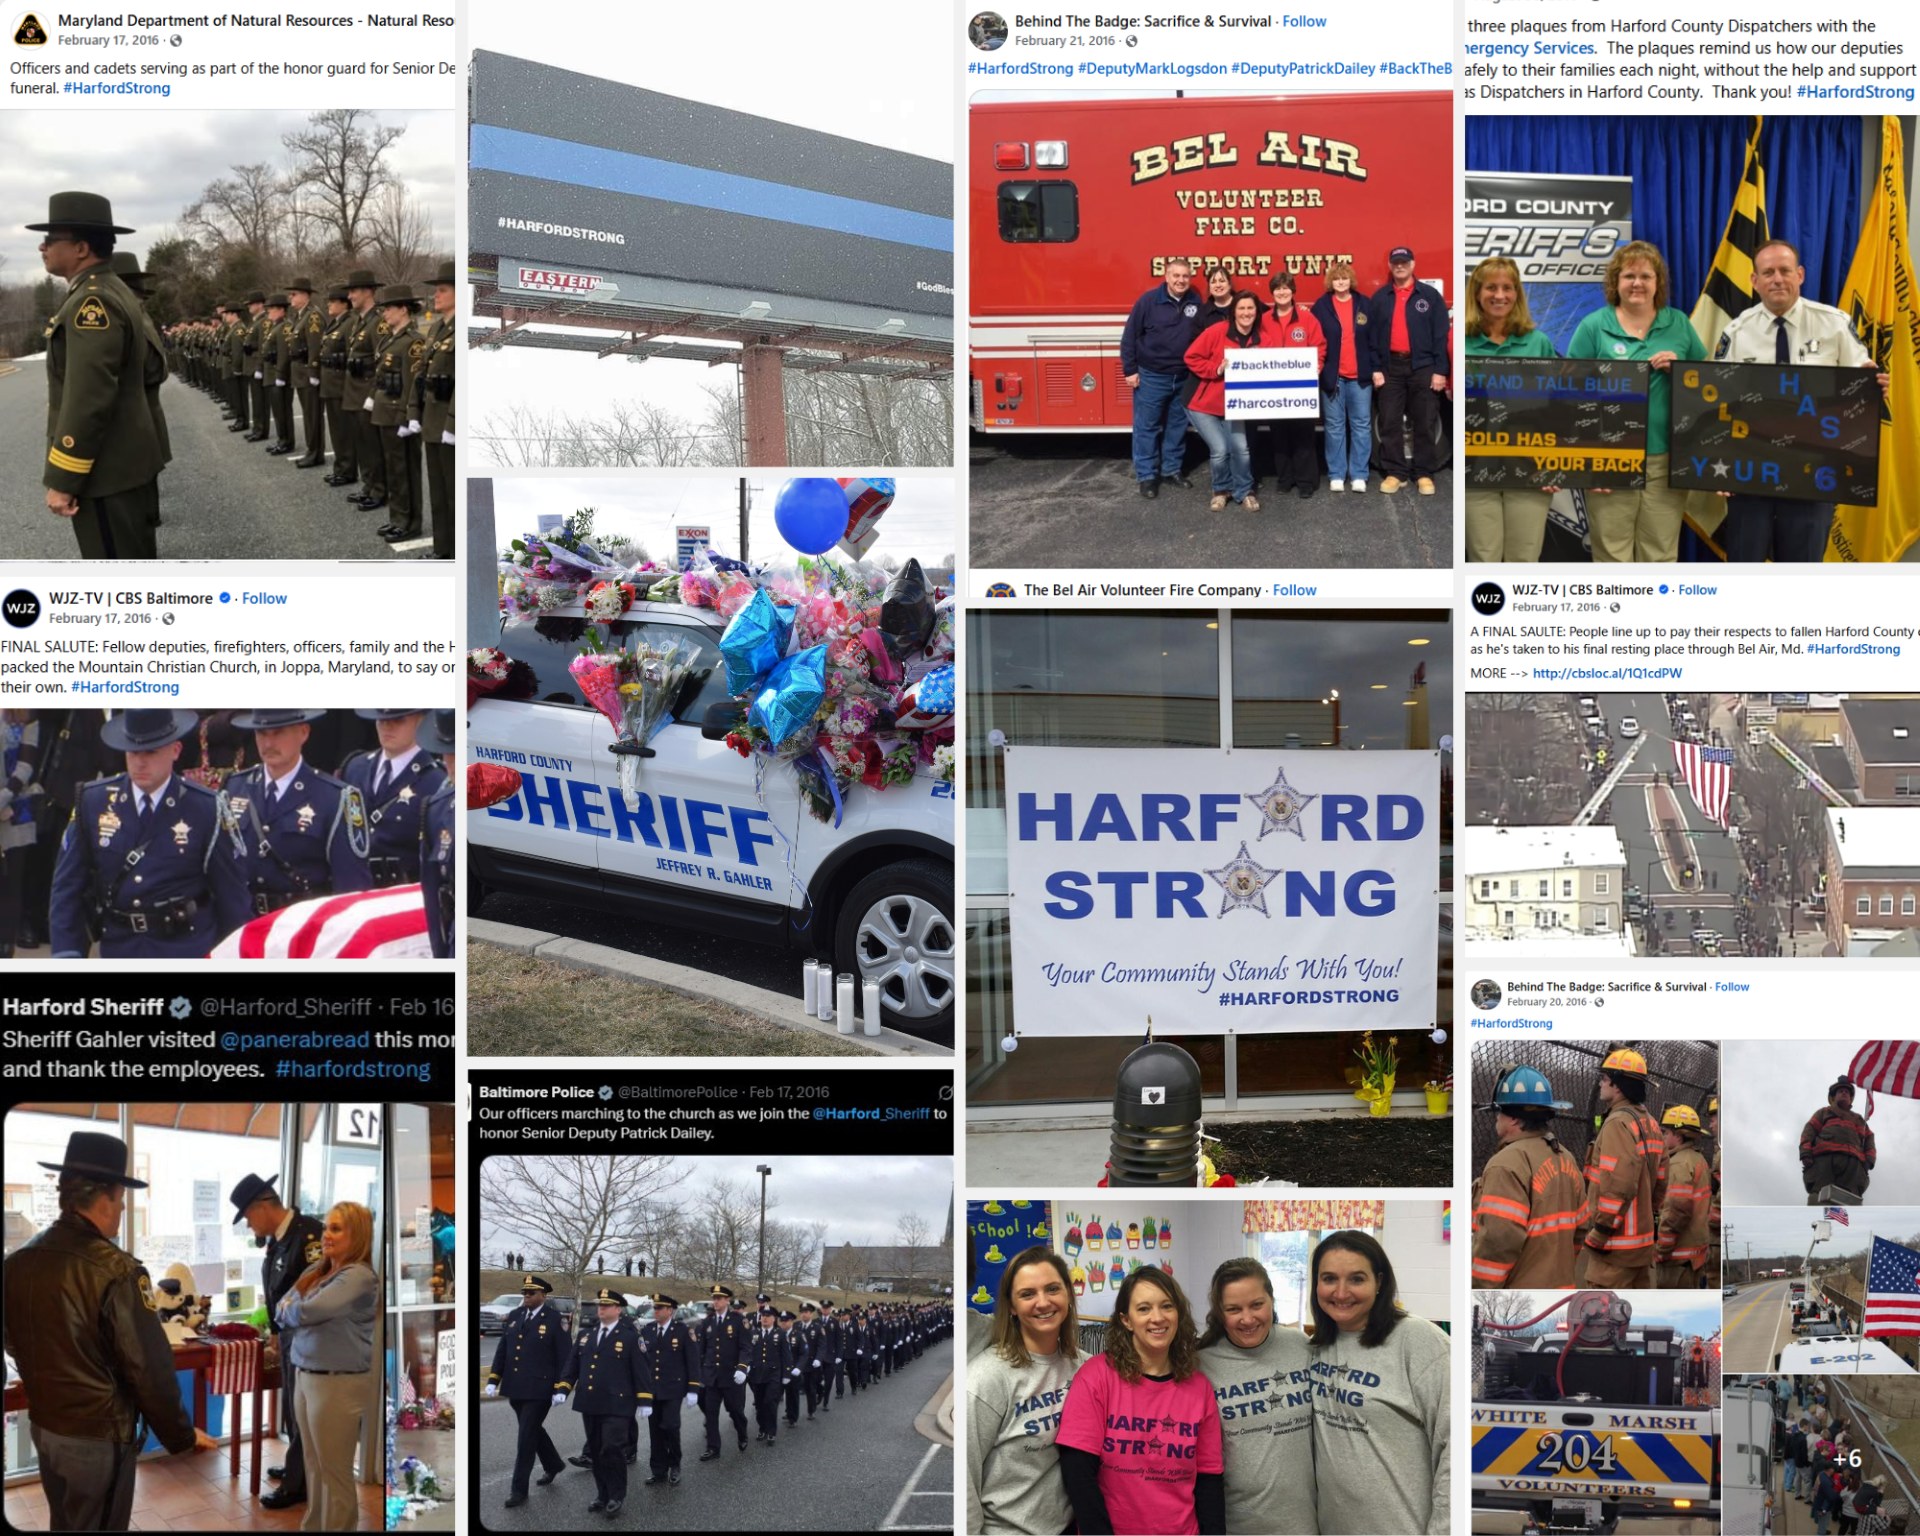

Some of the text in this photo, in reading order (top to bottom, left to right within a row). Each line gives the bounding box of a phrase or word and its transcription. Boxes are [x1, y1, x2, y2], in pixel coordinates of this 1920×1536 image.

[1132, 131, 1368, 185] BEL AIR
[1176, 189, 1324, 209] VOLUNTEER
[1516, 200, 1614, 215] COUNTY
[498, 217, 625, 245] #HARFORDSTRONG
[1195, 217, 1305, 236] FIRE CO.
[1152, 255, 1272, 277] SPPORT
[1524, 263, 1606, 276] OFFICE
[1231, 359, 1312, 371] #backtheblue
[1465, 374, 1633, 392] STAND TALL BLUE
[1227, 396, 1318, 413] #harcostrong
[1779, 373, 1840, 440] HAS
[1517, 432, 1557, 447] HAS
[1533, 456, 1643, 473] YOUR BACK
[677, 528, 710, 539] EXXON
[476, 746, 573, 772] HARFORD COUNTY
[930, 781, 954, 799] 2
[1017, 792, 1425, 842] HARFRD
[656, 857, 773, 892] JEFFREY R. GAHLER
[1043, 869, 1396, 920] STRNG
[1042, 954, 1403, 993] Your Community Stands With You!
[1219, 989, 1400, 1007] #HARFORDSTRONG
[1810, 1354, 1876, 1364] E-202
[1471, 1408, 1697, 1430] WHITE MARSH
[1536, 1432, 1618, 1473] 204
[1497, 1479, 1656, 1496] VOLUNTEERS
